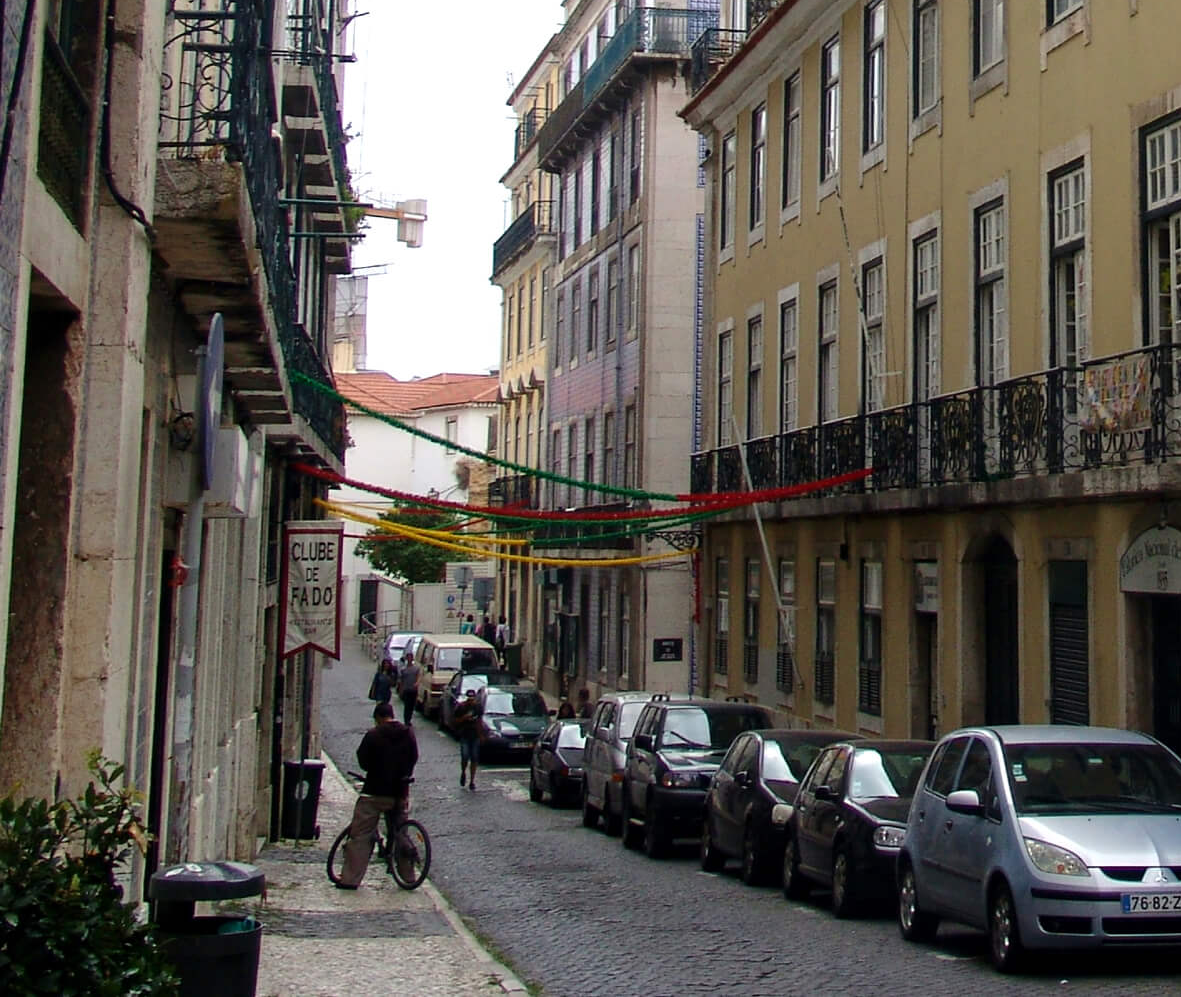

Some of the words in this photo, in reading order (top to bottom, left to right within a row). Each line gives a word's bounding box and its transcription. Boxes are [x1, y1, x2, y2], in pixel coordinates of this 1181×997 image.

[291, 542, 335, 561] CLUBE
[306, 567, 319, 582] DE
[291, 586, 333, 607] FADO
